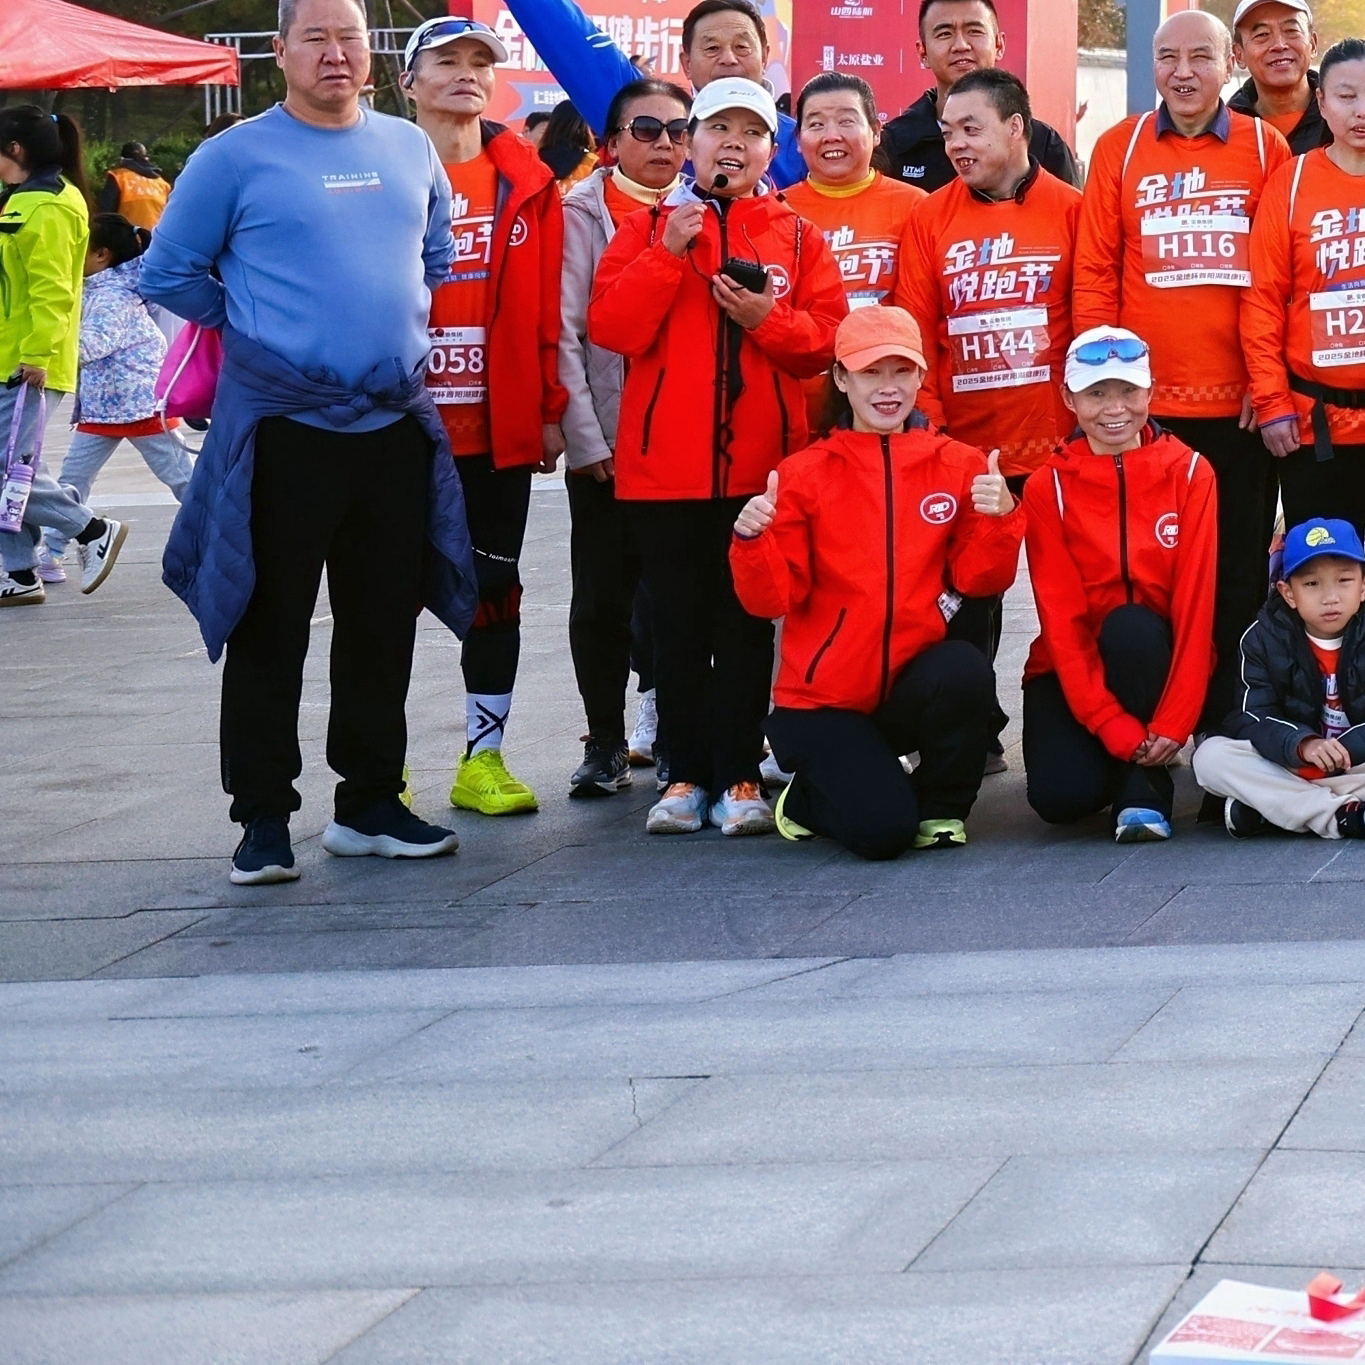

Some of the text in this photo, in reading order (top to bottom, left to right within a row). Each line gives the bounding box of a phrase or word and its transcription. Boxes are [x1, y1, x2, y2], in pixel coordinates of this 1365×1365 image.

[1135, 166, 1250, 208] 金地
[942, 232, 1062, 276] 金地
[1158, 233, 1236, 259] H116
[948, 263, 1054, 312] 悦跑节
[961, 329, 1036, 361] H144
